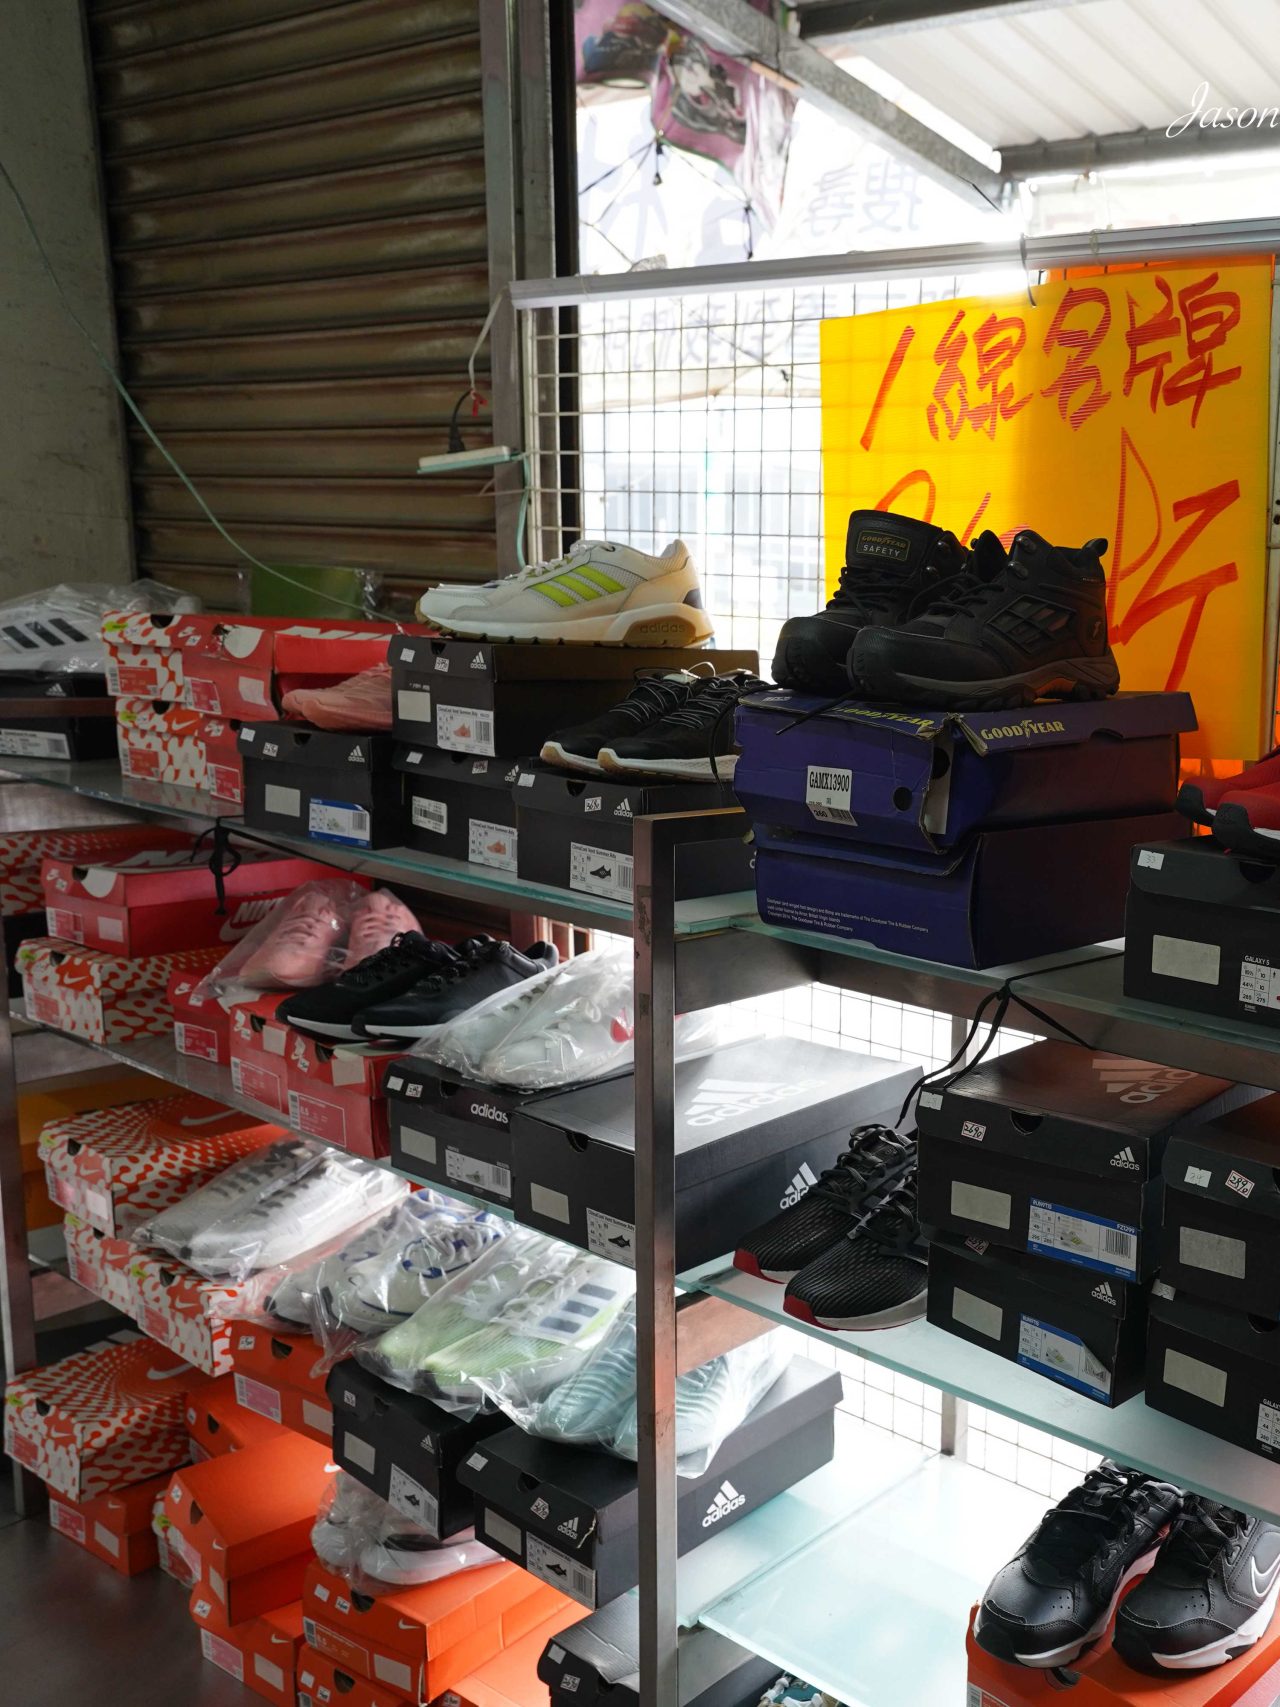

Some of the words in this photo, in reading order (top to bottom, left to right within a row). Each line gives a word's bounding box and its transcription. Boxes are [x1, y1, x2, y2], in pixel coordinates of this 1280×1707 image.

[863, 544, 900, 557] SAFETY
[639, 622, 686, 635] adidas
[981, 719, 1065, 740] GOODYEAR
[1244, 955, 1265, 966] GALAXY
[470, 1102, 509, 1124] adidas
[1110, 1157, 1140, 1171] adidas
[1229, 1175, 1250, 1195] 2890
[1091, 1290, 1117, 1306] adidas
[702, 1494, 746, 1528] adidas
[557, 1525, 578, 1540] adidas
